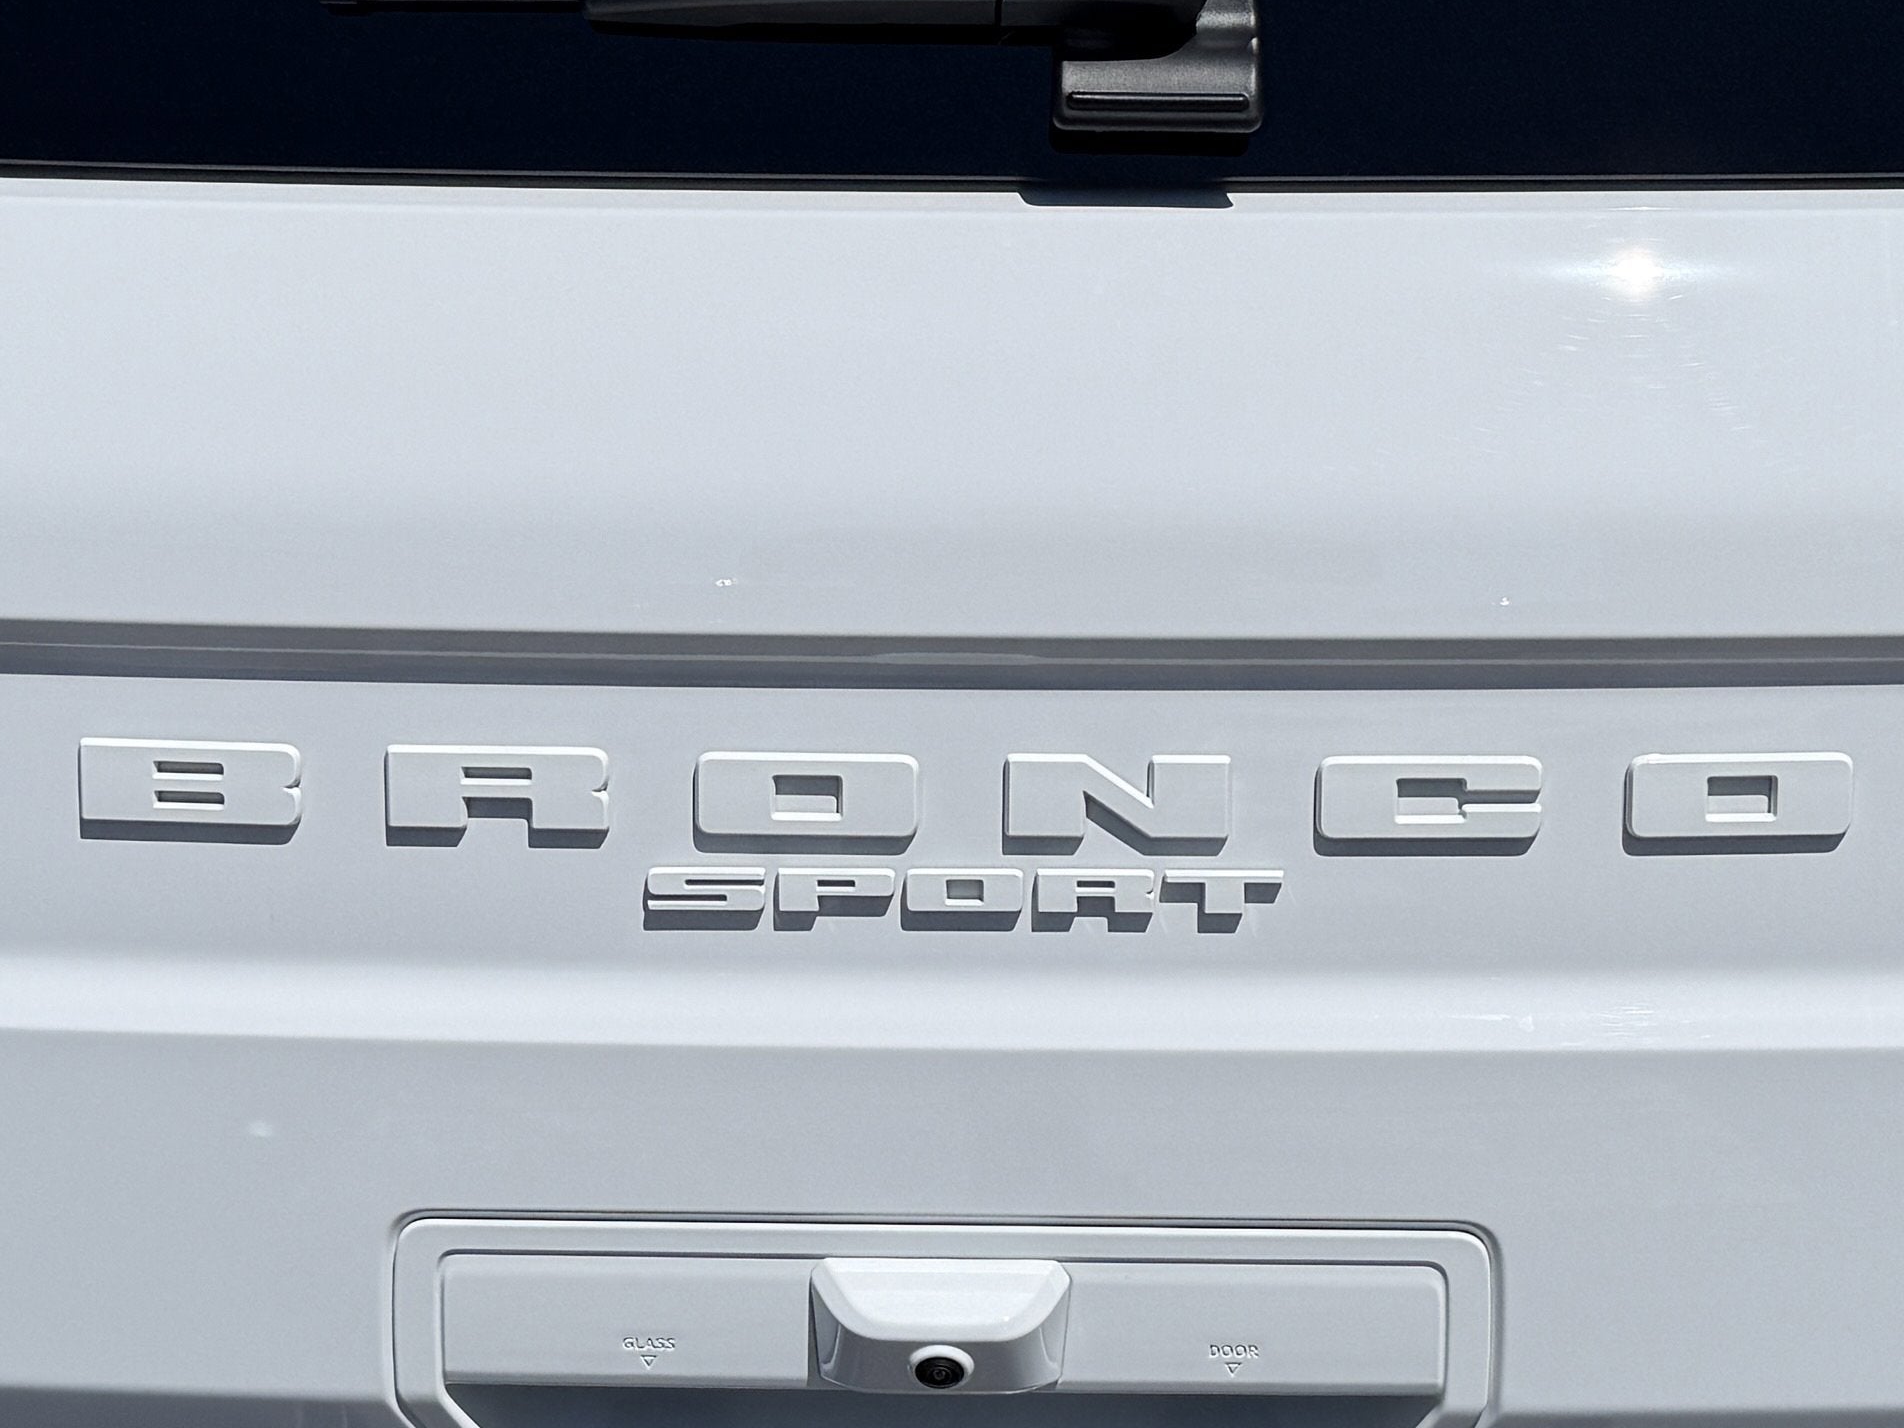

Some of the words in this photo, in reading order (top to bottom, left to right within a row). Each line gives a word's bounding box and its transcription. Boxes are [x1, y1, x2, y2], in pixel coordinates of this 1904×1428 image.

[77, 734, 1855, 856] BRONCO
[640, 863, 1285, 933] SPORT
[622, 1336, 676, 1350] GLASS
[1209, 1344, 1259, 1358] DOOR
